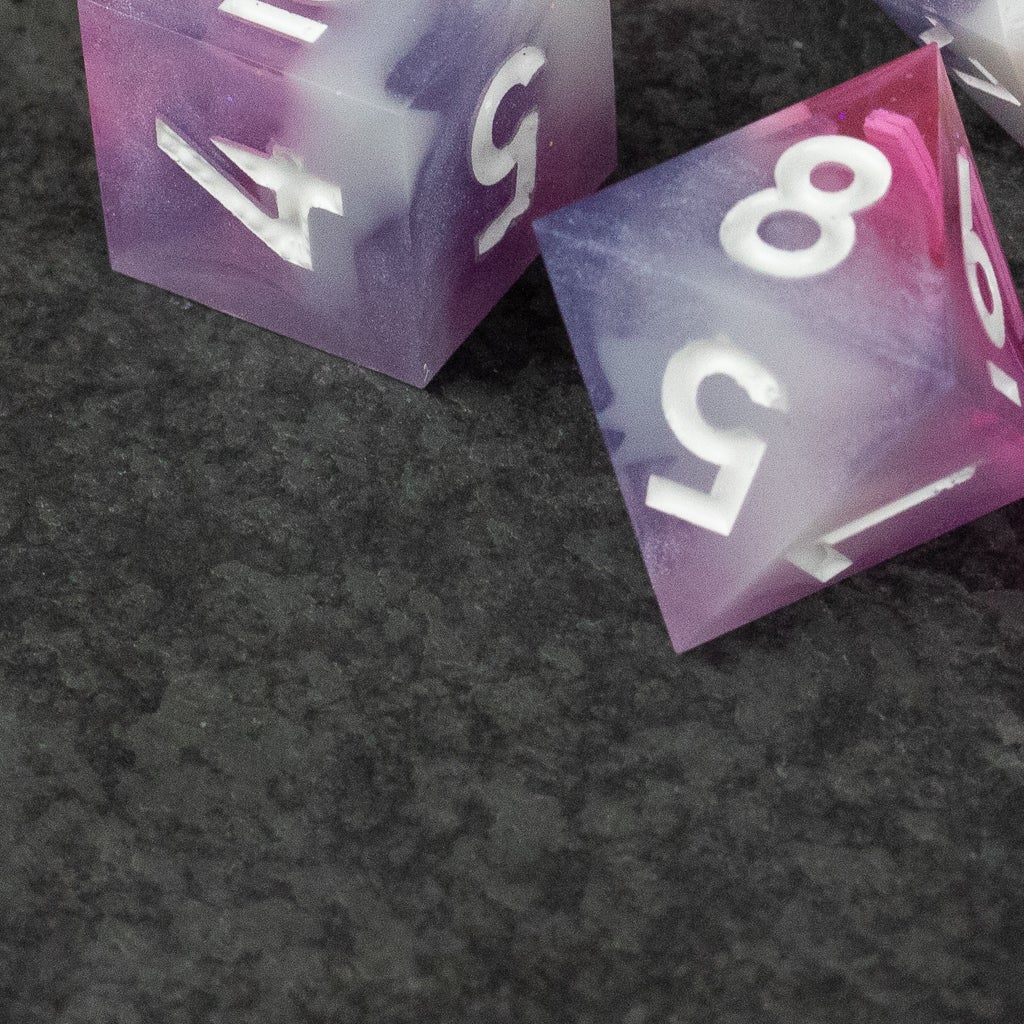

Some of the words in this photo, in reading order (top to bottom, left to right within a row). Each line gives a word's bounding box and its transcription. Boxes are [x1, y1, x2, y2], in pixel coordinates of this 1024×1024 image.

[155, 117, 344, 271] 4
[471, 45, 547, 256] 5
[719, 134, 893, 279] 8
[645, 338, 788, 538] 5
